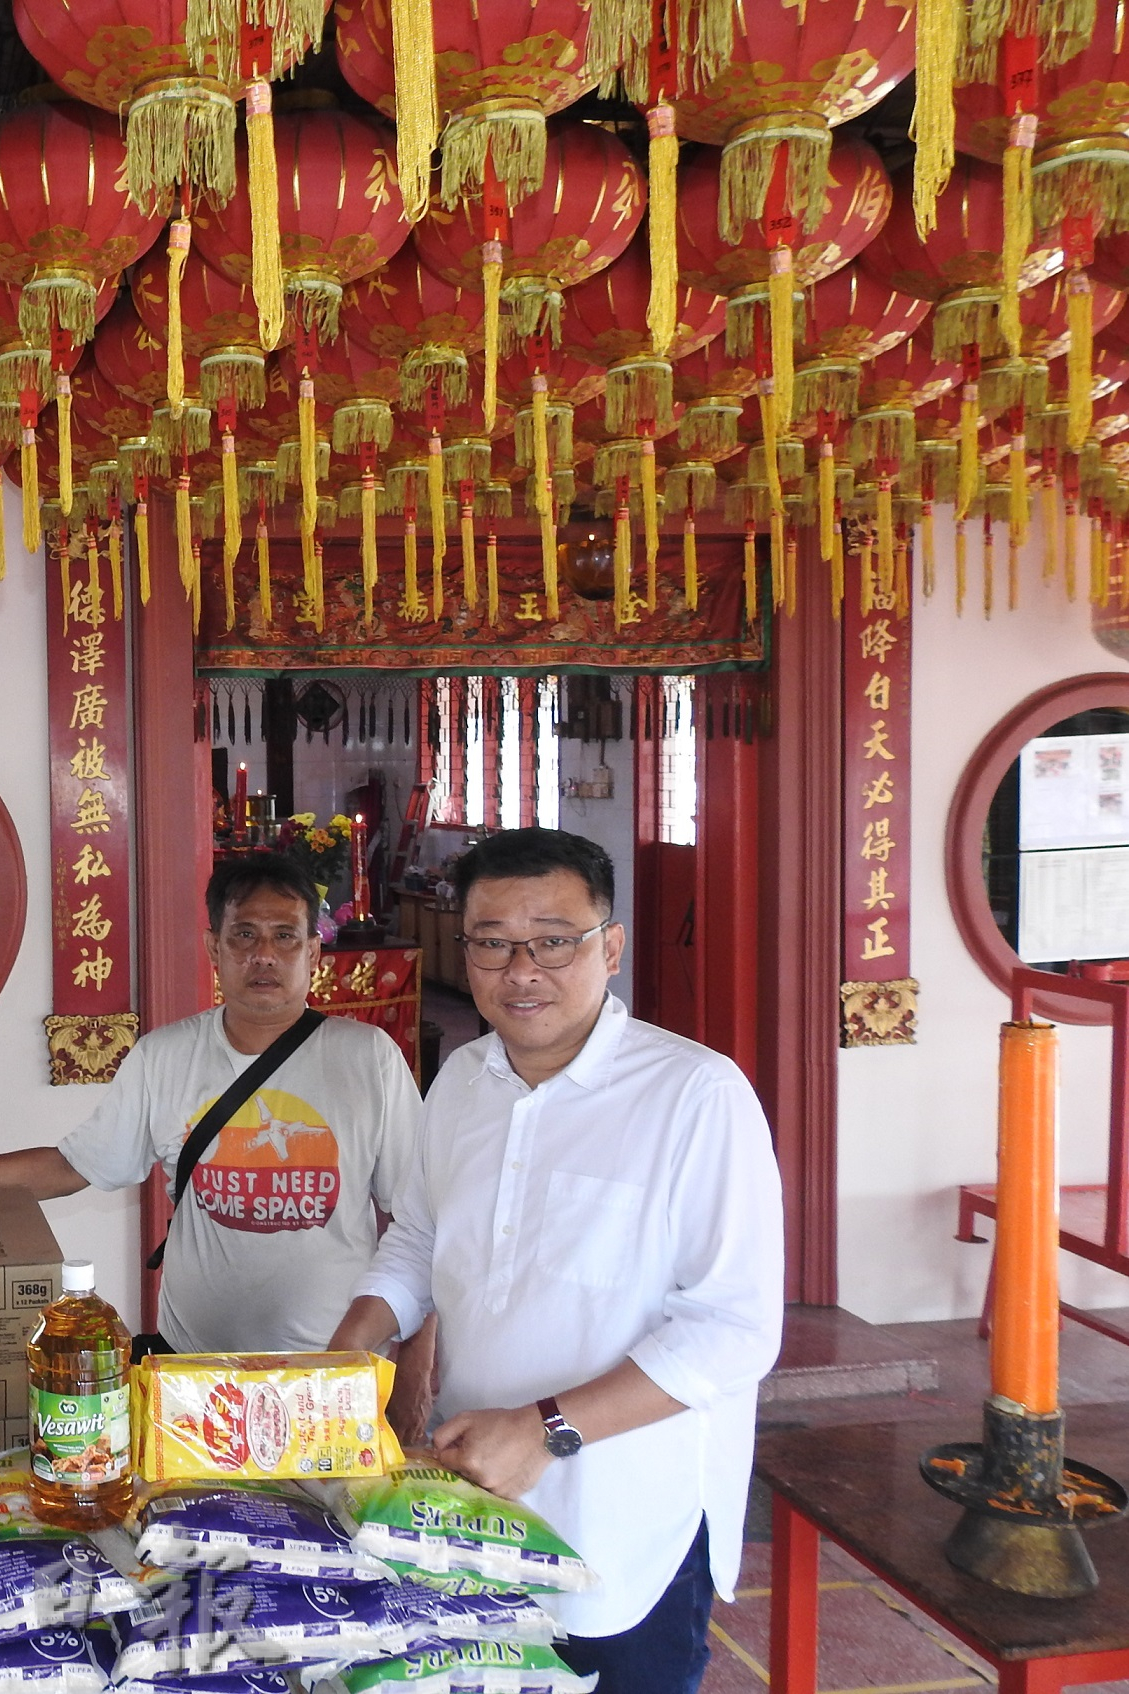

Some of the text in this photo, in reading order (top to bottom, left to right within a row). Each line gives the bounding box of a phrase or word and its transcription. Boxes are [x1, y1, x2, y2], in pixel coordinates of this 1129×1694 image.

[272, 1171, 336, 1195] NEED
[252, 1194, 328, 1221] SPACE
[17, 1283, 48, 1297] 368g
[37, 1412, 106, 1438] Vesawit
[313, 1587, 350, 1606] 5%
[39, 1629, 79, 1648] 5%
